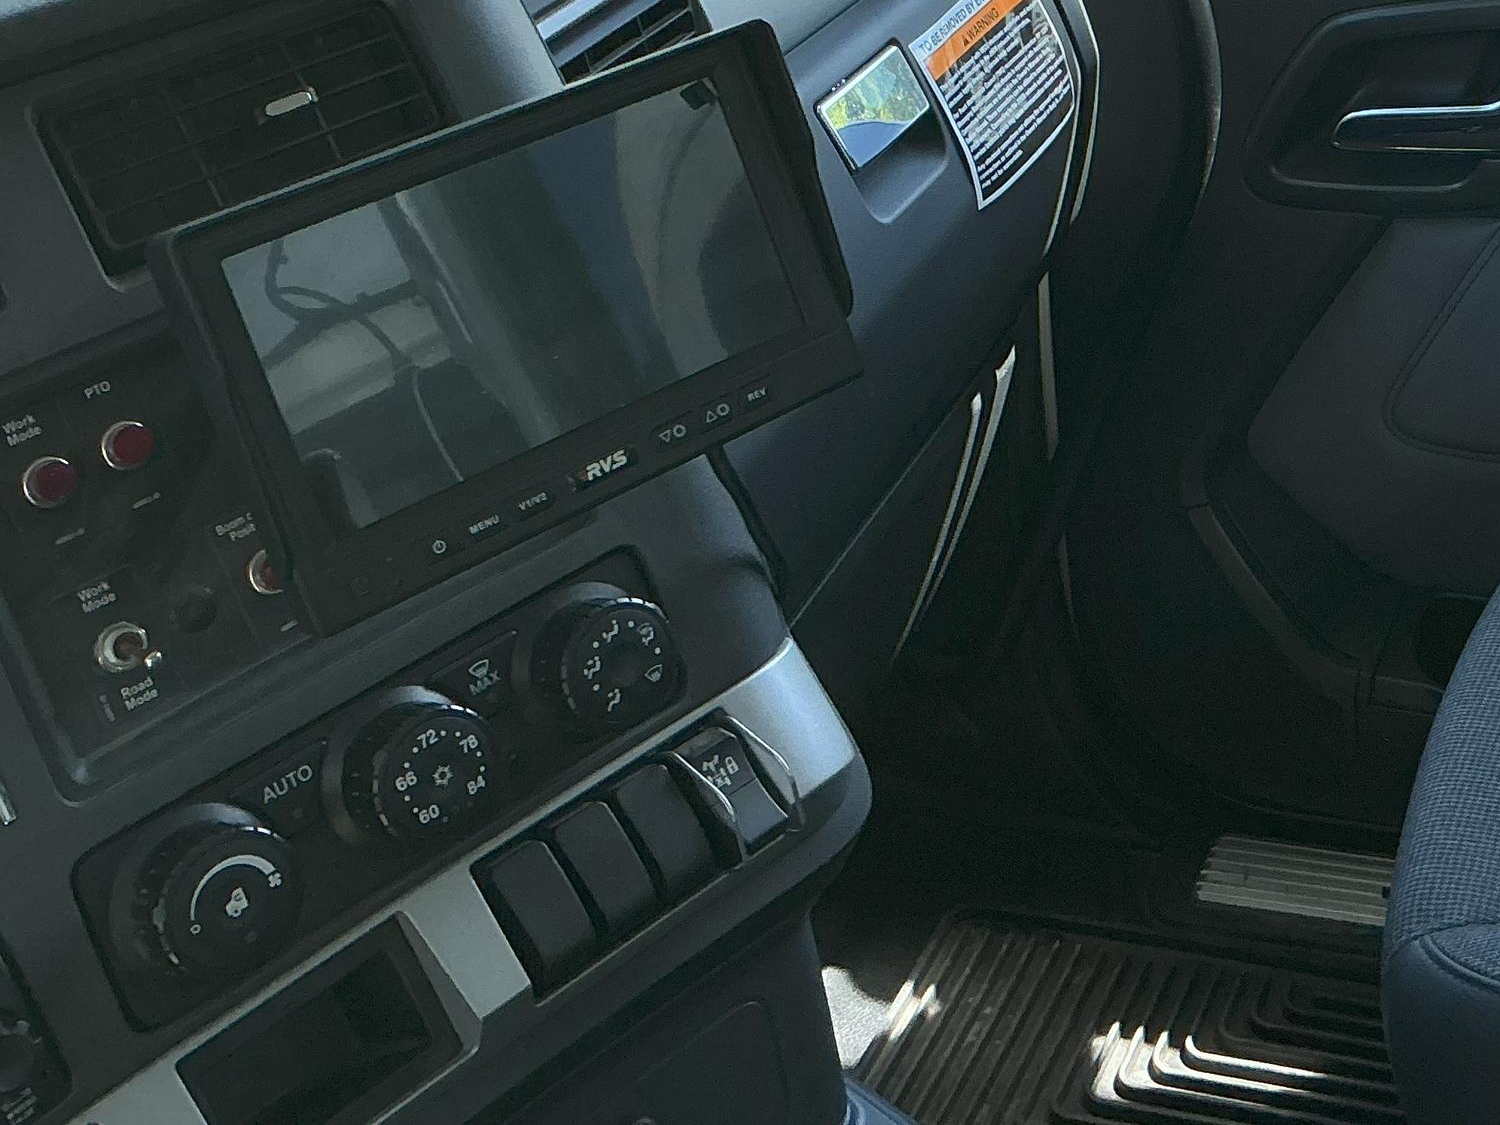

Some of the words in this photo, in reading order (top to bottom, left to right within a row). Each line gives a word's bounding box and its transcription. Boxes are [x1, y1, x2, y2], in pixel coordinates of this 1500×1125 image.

[919, 39, 933, 54] TO
[930, 32, 943, 45] BE
[939, 8, 968, 38] REMOVED
[965, 0, 975, 14] BY
[966, 7, 1000, 40] WARNING
[84, 380, 111, 399] PTO
[2, 414, 36, 435] Work
[6, 424, 42, 446] Mode
[586, 449, 628, 481] RVS
[468, 514, 500, 535] MENU
[77, 581, 111, 601] Work
[82, 593, 116, 613] Mode
[120, 677, 153, 699] Road
[125, 689, 158, 711] Mode
[417, 727, 439, 750] 72
[459, 734, 480, 755] 78
[262, 763, 313, 805] AUTO
[394, 769, 418, 792] 66
[466, 774, 487, 796] 84
[418, 803, 440, 824] 60
